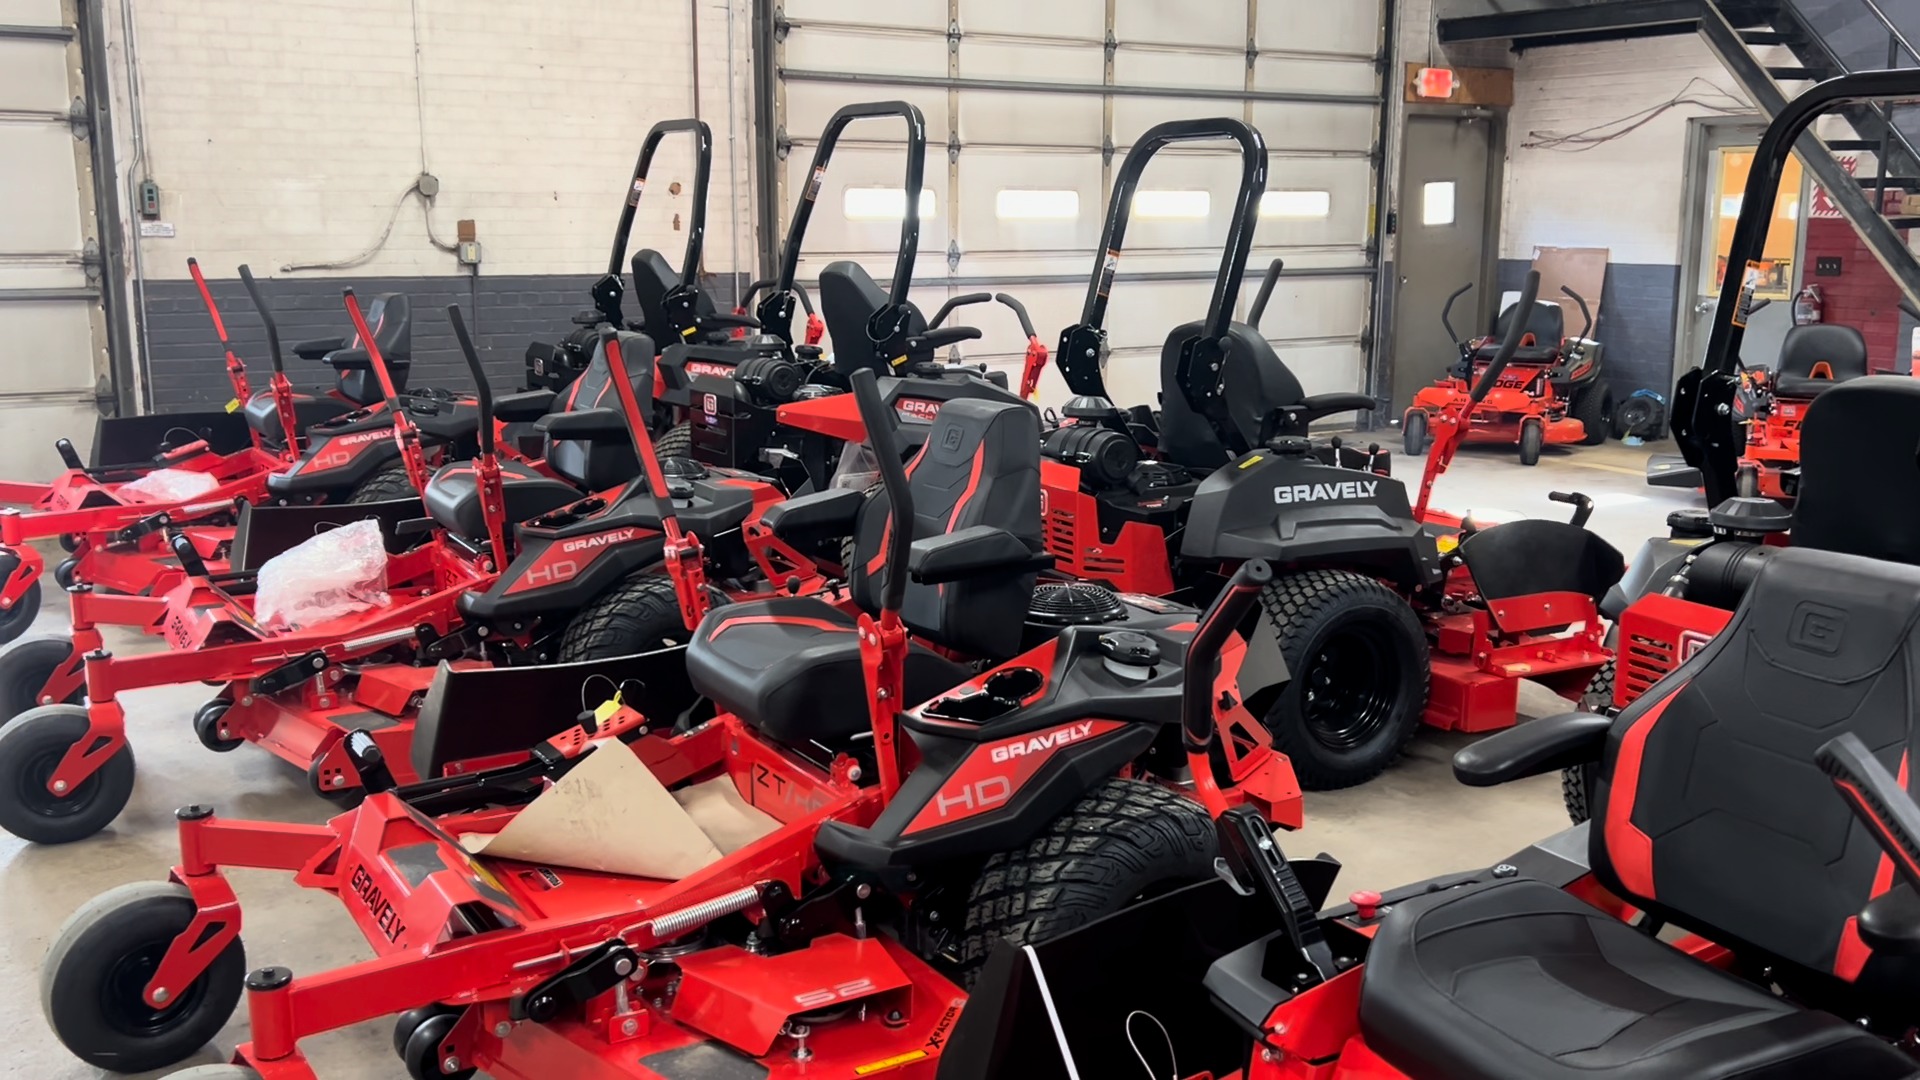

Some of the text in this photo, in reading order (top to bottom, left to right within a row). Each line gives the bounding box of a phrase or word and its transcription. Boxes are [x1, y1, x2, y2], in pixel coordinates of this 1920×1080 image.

[338, 429, 392, 446] GRAVELY
[313, 451, 350, 468] HD
[1274, 480, 1378, 504] GRAVELY
[562, 528, 635, 553] GRAVELY
[526, 560, 577, 584] HD
[990, 720, 1093, 764] GRAVELY
[936, 775, 1012, 817] HD
[351, 863, 406, 944] GRAVELY
[925, 1006, 958, 1050] X-FACTOR
